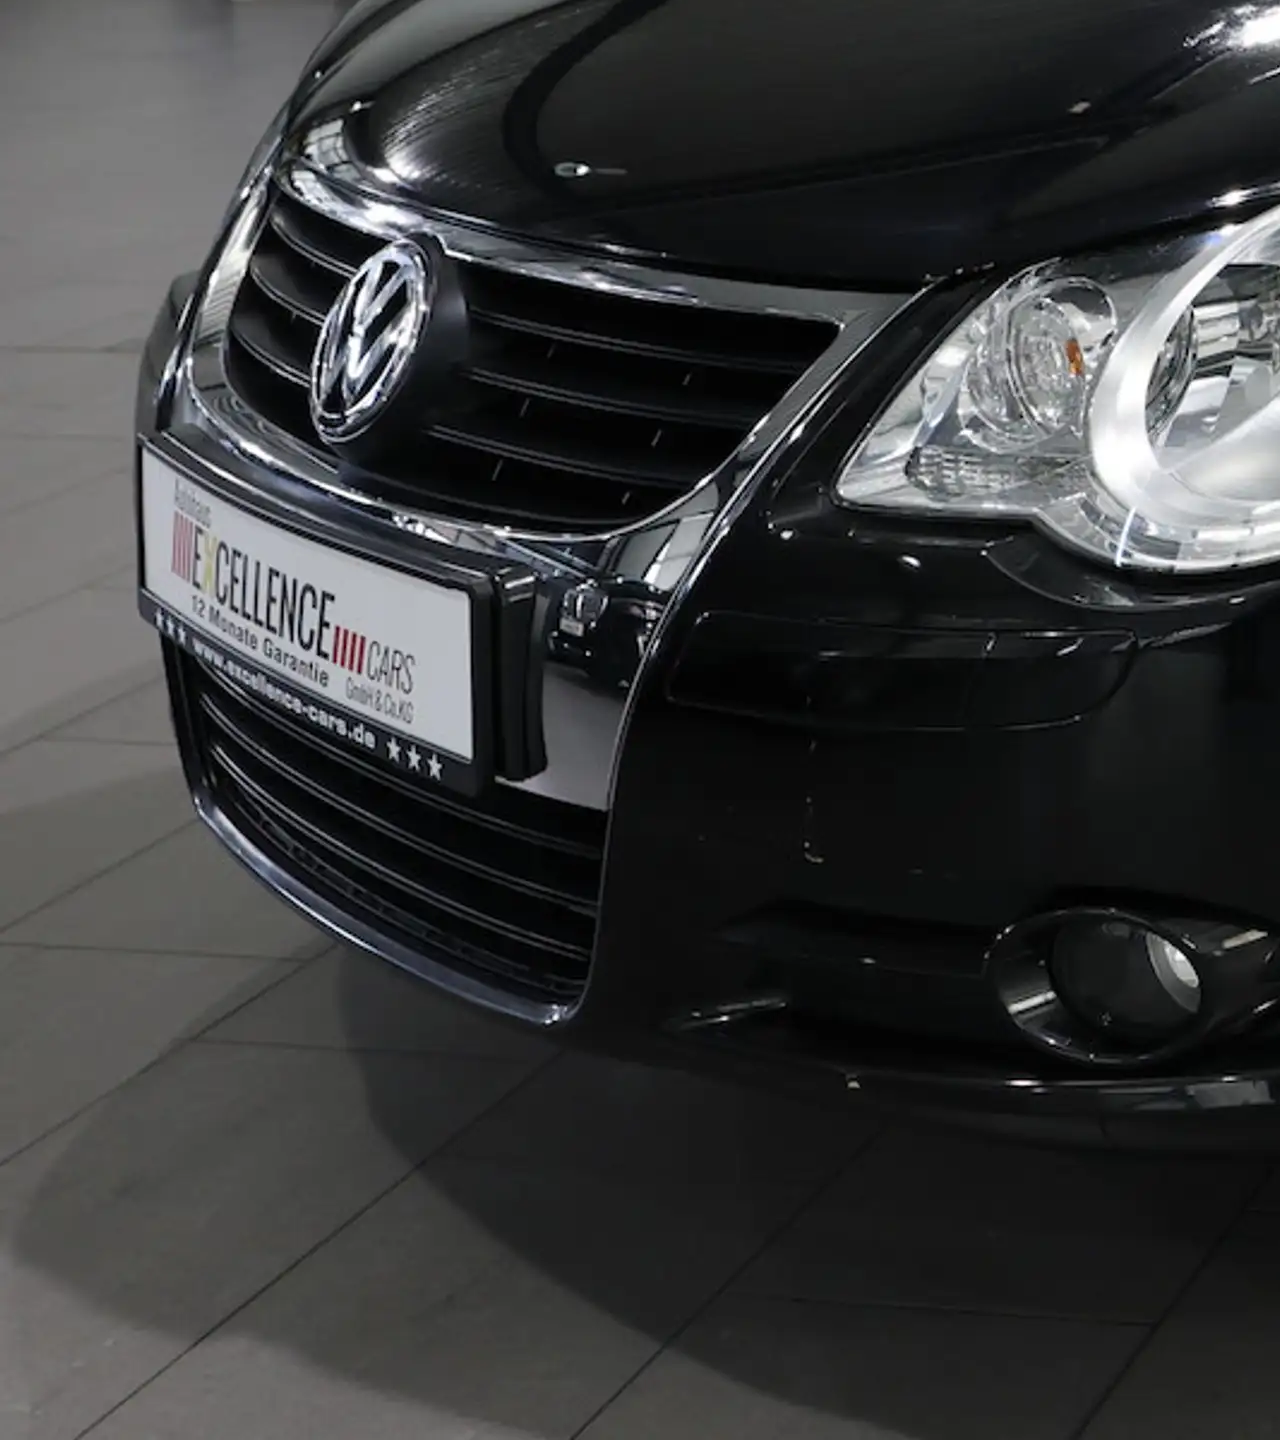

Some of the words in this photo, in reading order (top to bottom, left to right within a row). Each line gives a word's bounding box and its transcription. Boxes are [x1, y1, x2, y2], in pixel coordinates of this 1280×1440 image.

[192, 524, 336, 660] EXCELLENCE
[366, 640, 416, 695] CARS
[192, 594, 207, 618] 12
[208, 605, 258, 651] Monate
[262, 636, 331, 689] Garantie
